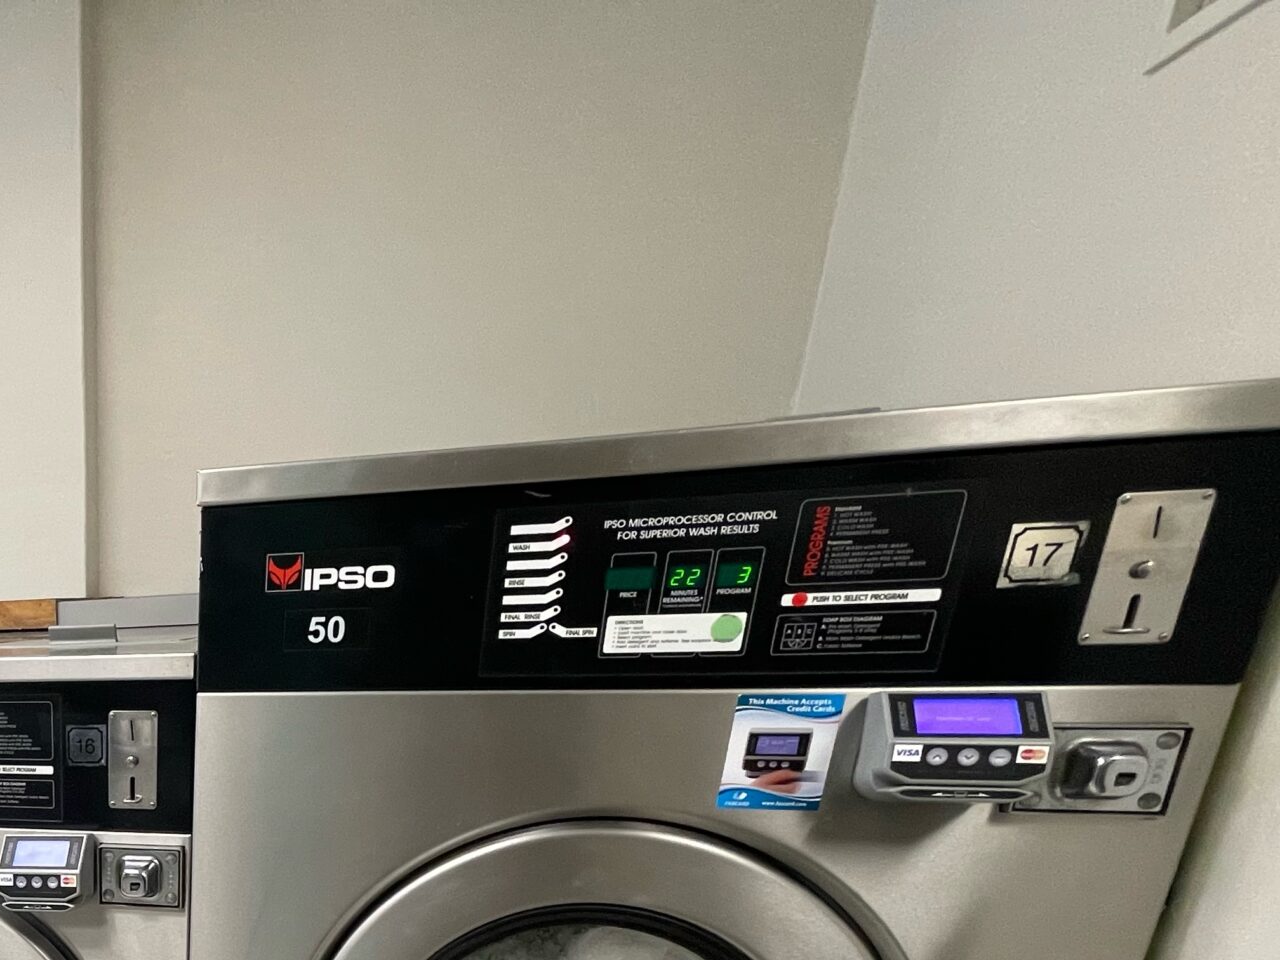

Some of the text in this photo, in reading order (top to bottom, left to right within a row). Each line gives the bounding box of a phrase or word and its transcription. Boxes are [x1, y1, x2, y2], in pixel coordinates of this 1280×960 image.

[603, 510, 778, 529] IPSO MICROPROCESSOR CONTROL
[617, 523, 761, 541] FOR SUPERIOR WASH RESULTS
[803, 505, 832, 576] PROGRAMS
[512, 543, 531, 551] WASH
[1025, 542, 1064, 567] 17
[303, 564, 396, 592] IPSO
[670, 567, 702, 587] 22
[737, 566, 752, 585] 3
[716, 587, 752, 595] PROGRAM
[832, 594, 842, 602] TO
[843, 593, 868, 601] SELECT
[869, 592, 909, 600] PROGRAM
[307, 615, 346, 644] 50
[800, 698, 832, 707] Accepts
[76, 738, 96, 755] 16
[896, 748, 920, 757] VISA
